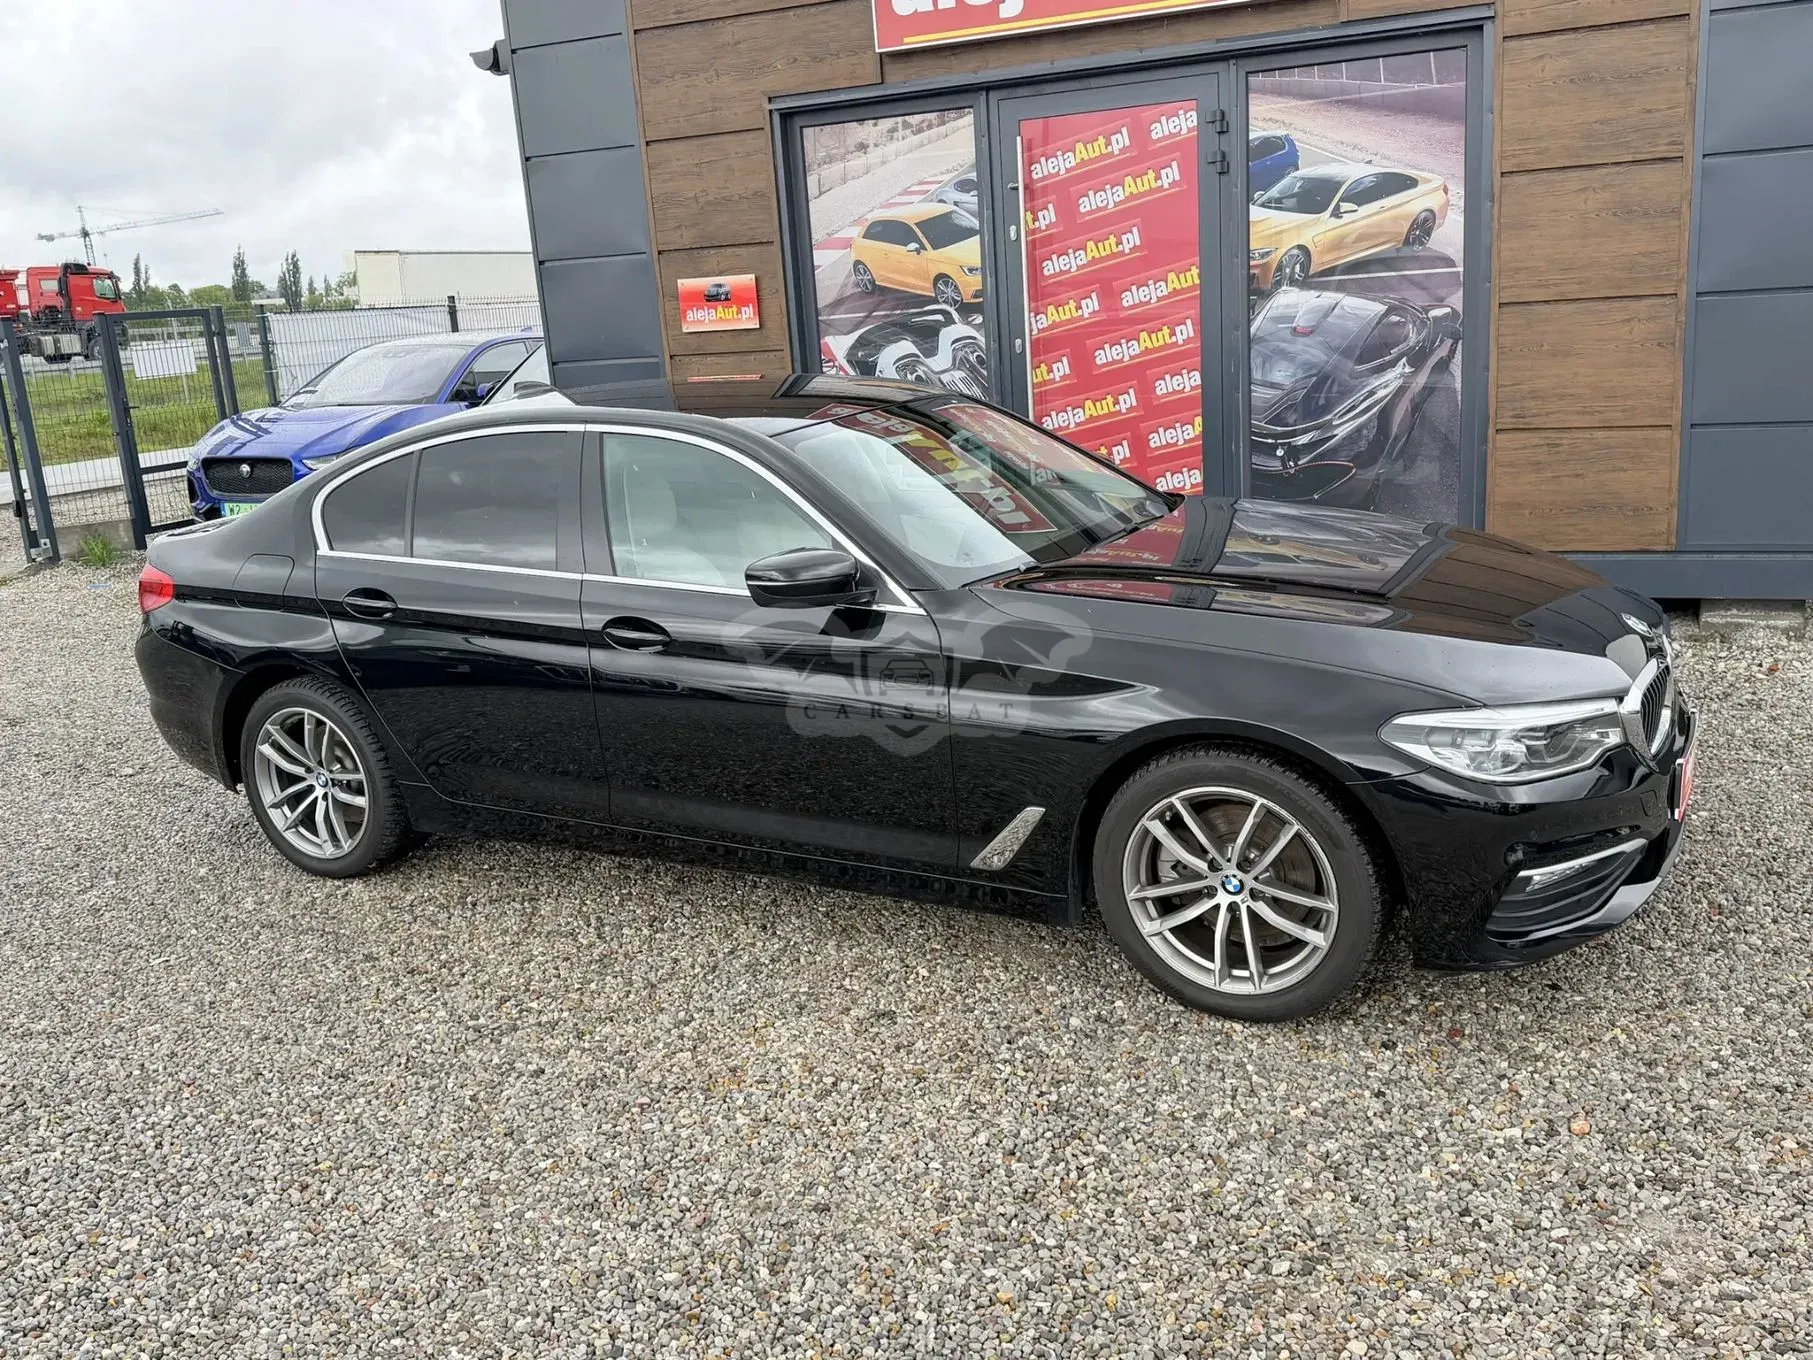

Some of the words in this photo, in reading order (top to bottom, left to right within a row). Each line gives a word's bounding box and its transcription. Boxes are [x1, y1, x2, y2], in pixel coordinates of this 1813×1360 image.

[1150, 110, 1197, 139] aleja
[1031, 126, 1130, 179] alejaAut.pl
[1079, 160, 1180, 213] alejaAut.pl
[1042, 226, 1141, 276] alejaAut.pl
[1121, 265, 1200, 307] alejaAut
[686, 304, 753, 323] alejaAut.pl
[1094, 319, 1194, 366] alejaAut.pl
[1154, 368, 1201, 396] aleja
[1041, 388, 1137, 430] alejaAut.pl
[1155, 467, 1201, 492] aleja
